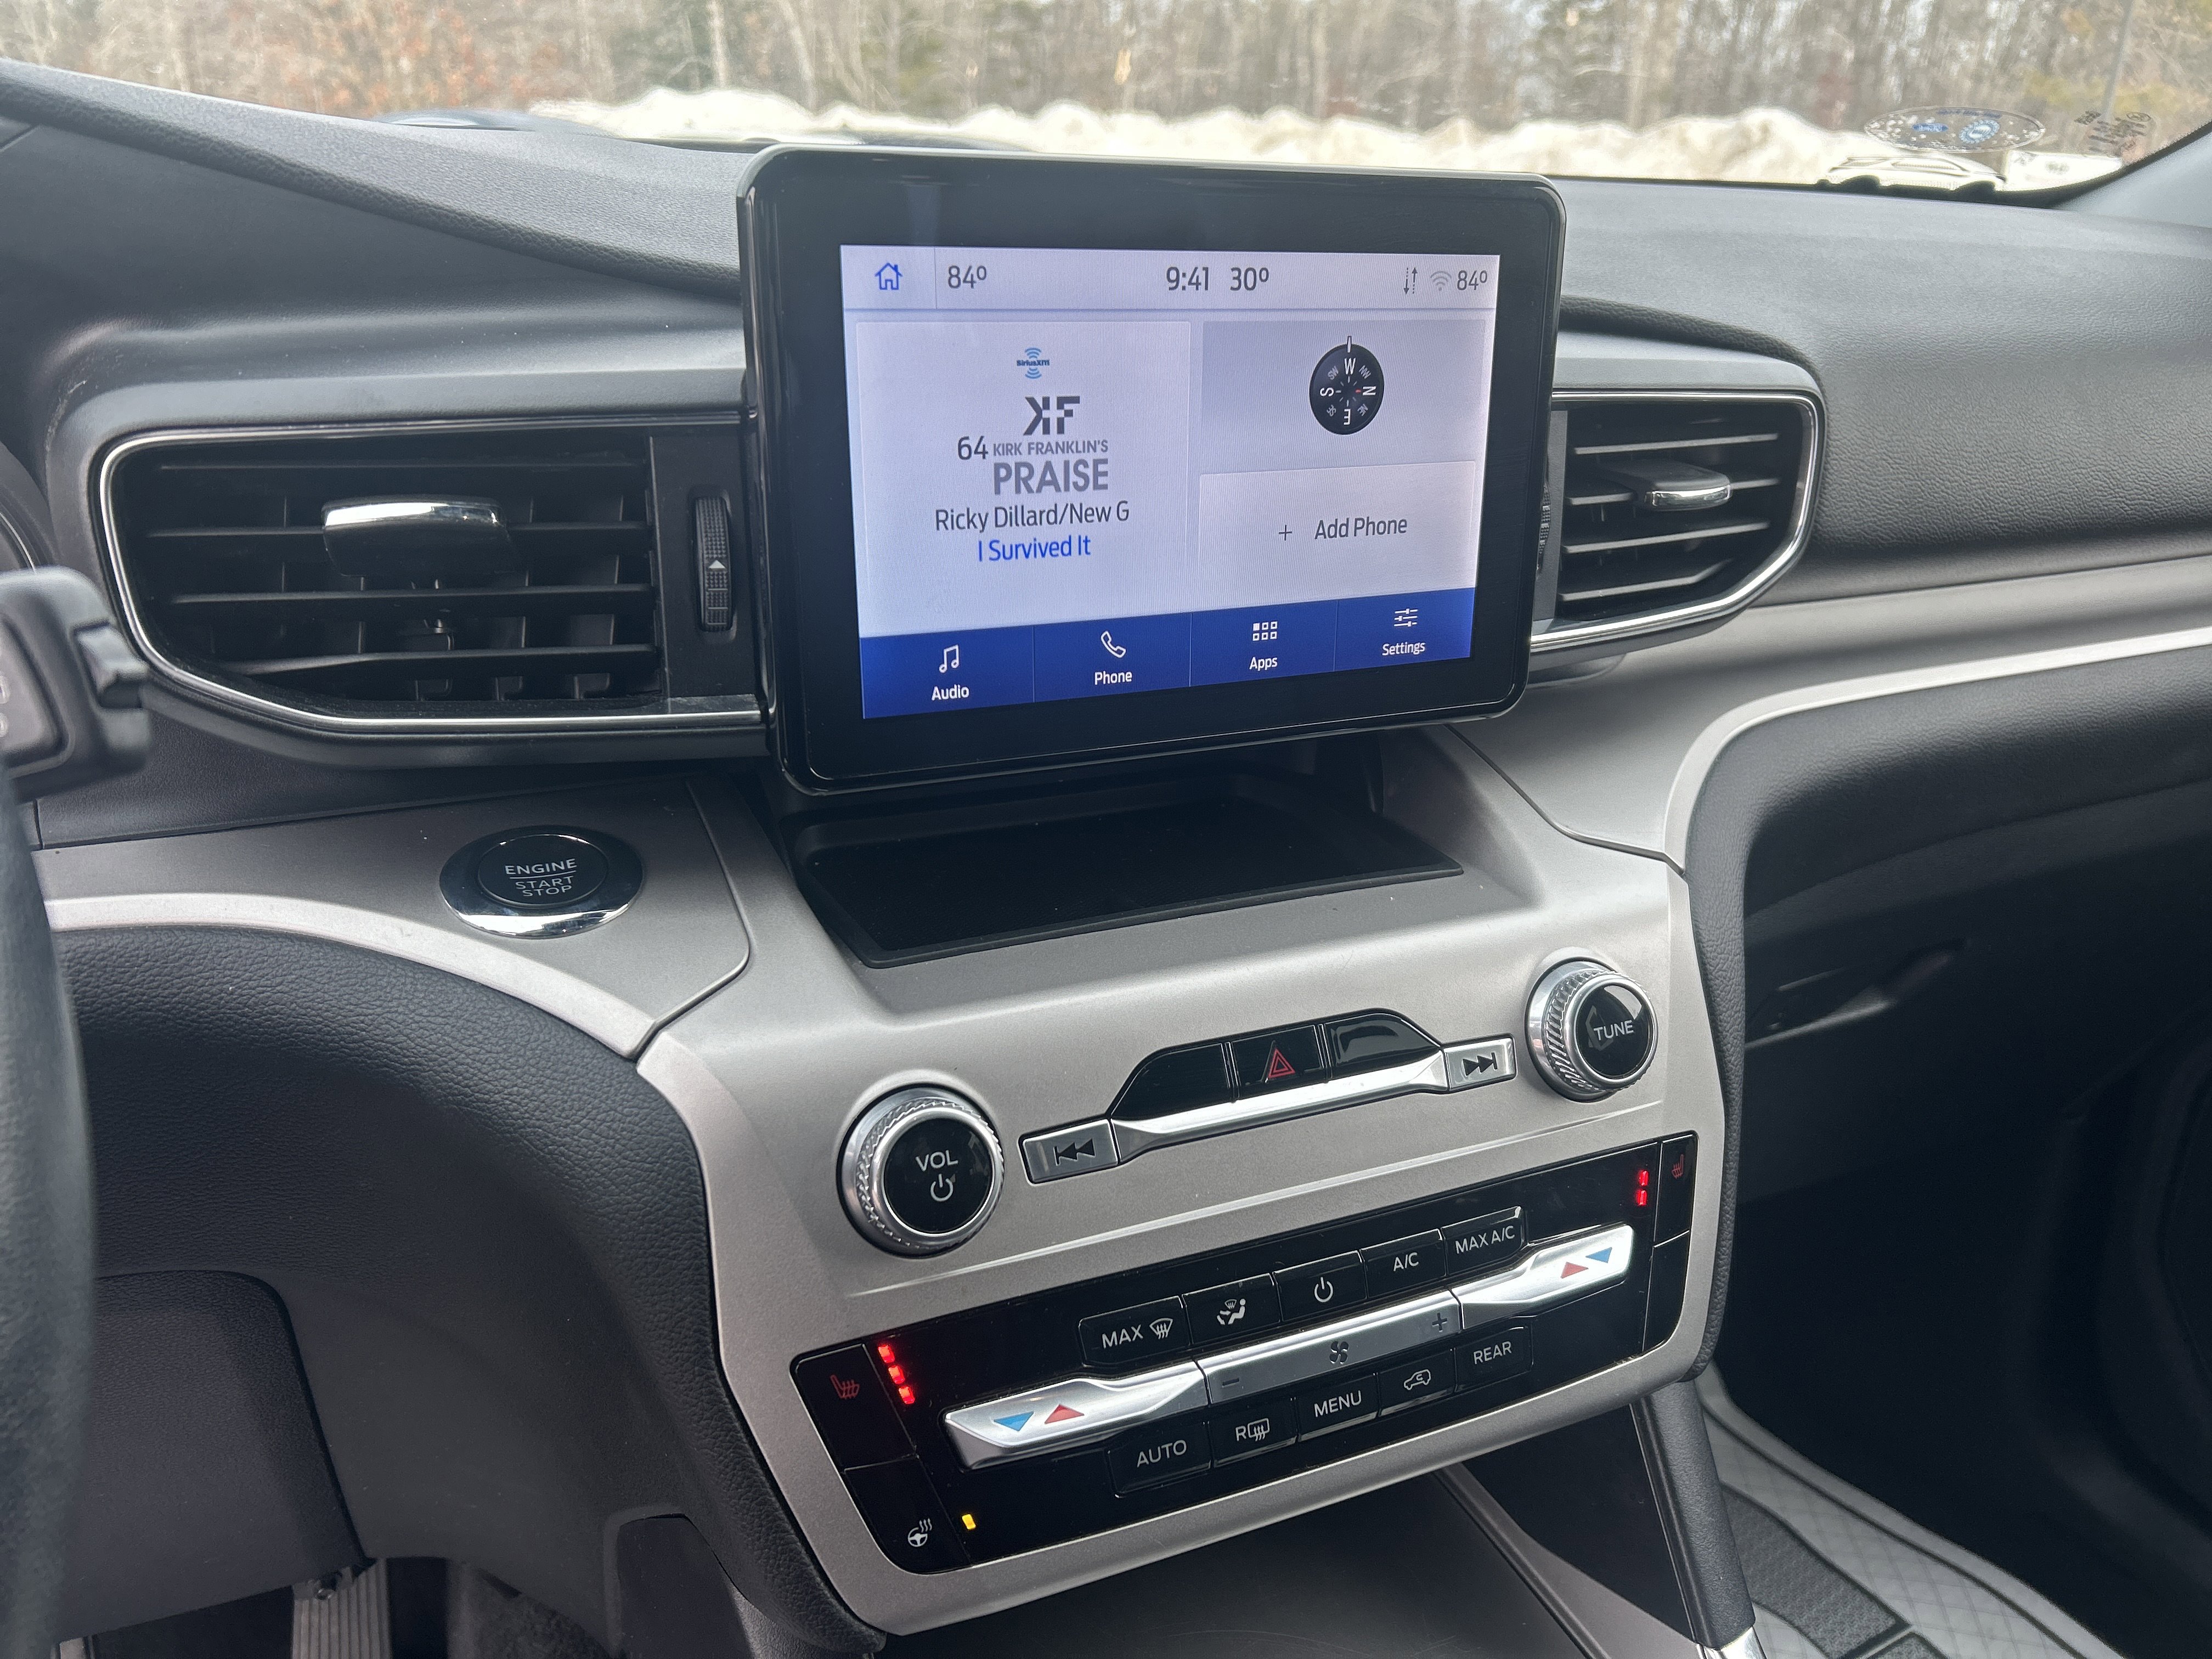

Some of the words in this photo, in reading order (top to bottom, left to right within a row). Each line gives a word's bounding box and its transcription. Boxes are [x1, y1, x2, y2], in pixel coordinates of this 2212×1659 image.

[1166, 266, 1209, 291] 9:41
[1344, 358, 1356, 375] W
[1319, 387, 1334, 397] S
[1344, 409, 1351, 425] E
[957, 435, 989, 460] 64
[993, 442, 1023, 456] KIRK
[1028, 439, 1109, 455] FRANKLIN'S
[994, 458, 1109, 495] PRAISE
[935, 506, 989, 533] Ricky
[994, 503, 1111, 529] Dillard/New
[1116, 500, 1130, 522] G
[1314, 517, 1350, 540] Add
[1353, 516, 1408, 537] Phone
[978, 540, 983, 562] I
[989, 534, 1072, 562] Survived
[1077, 534, 1091, 556] It
[1382, 641, 1426, 656] Settings
[1249, 656, 1278, 672] Apps
[1094, 670, 1133, 686] Phone
[931, 684, 970, 702] Audio
[505, 857, 578, 875] ENGINE
[515, 876, 574, 890] START
[522, 885, 573, 897] STOP
[1593, 1019, 1634, 1041] TUNE
[915, 1149, 958, 1172] VOL
[1454, 1233, 1489, 1255] MAX
[1490, 1224, 1516, 1245] A/C
[1392, 1251, 1419, 1272] A/C
[1101, 1324, 1144, 1350] MAX
[1472, 1340, 1512, 1365] REAR
[1313, 1389, 1363, 1419] MENU
[1136, 1439, 1188, 1469] AUTO
